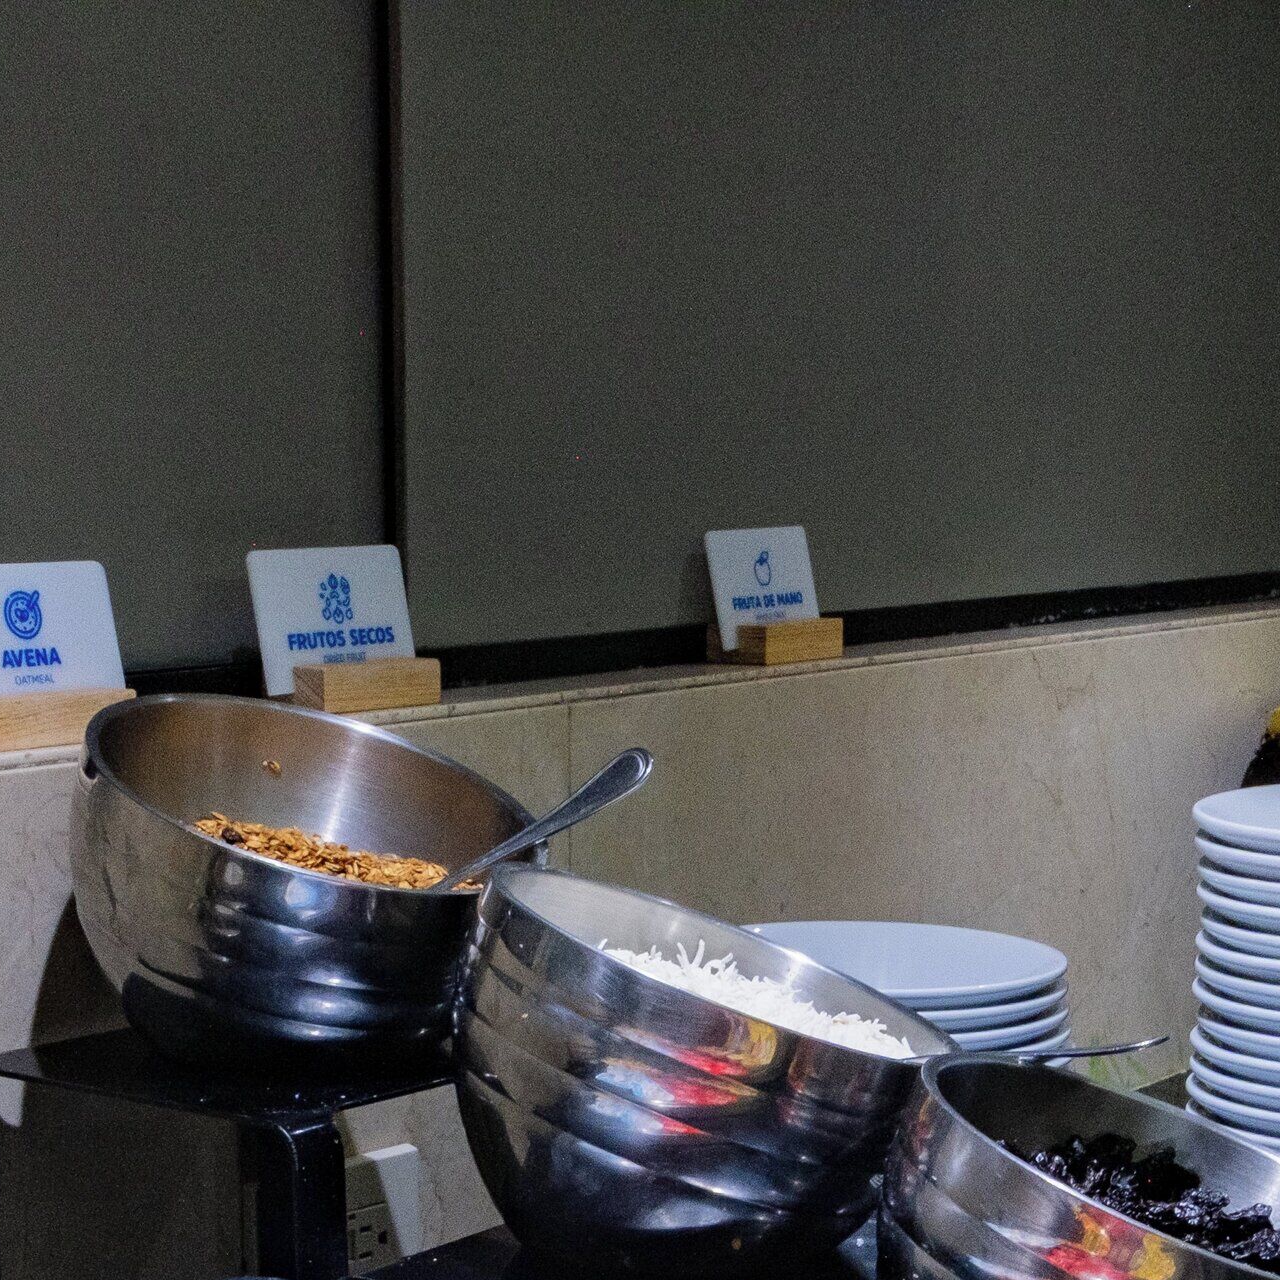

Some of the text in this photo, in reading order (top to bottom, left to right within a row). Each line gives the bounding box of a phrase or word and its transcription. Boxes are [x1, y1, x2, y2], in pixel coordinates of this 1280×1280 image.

[287, 626, 395, 651] FRUTOS SECOS
[2, 647, 62, 669] AVENA
[15, 674, 55, 686] OATMEAL
